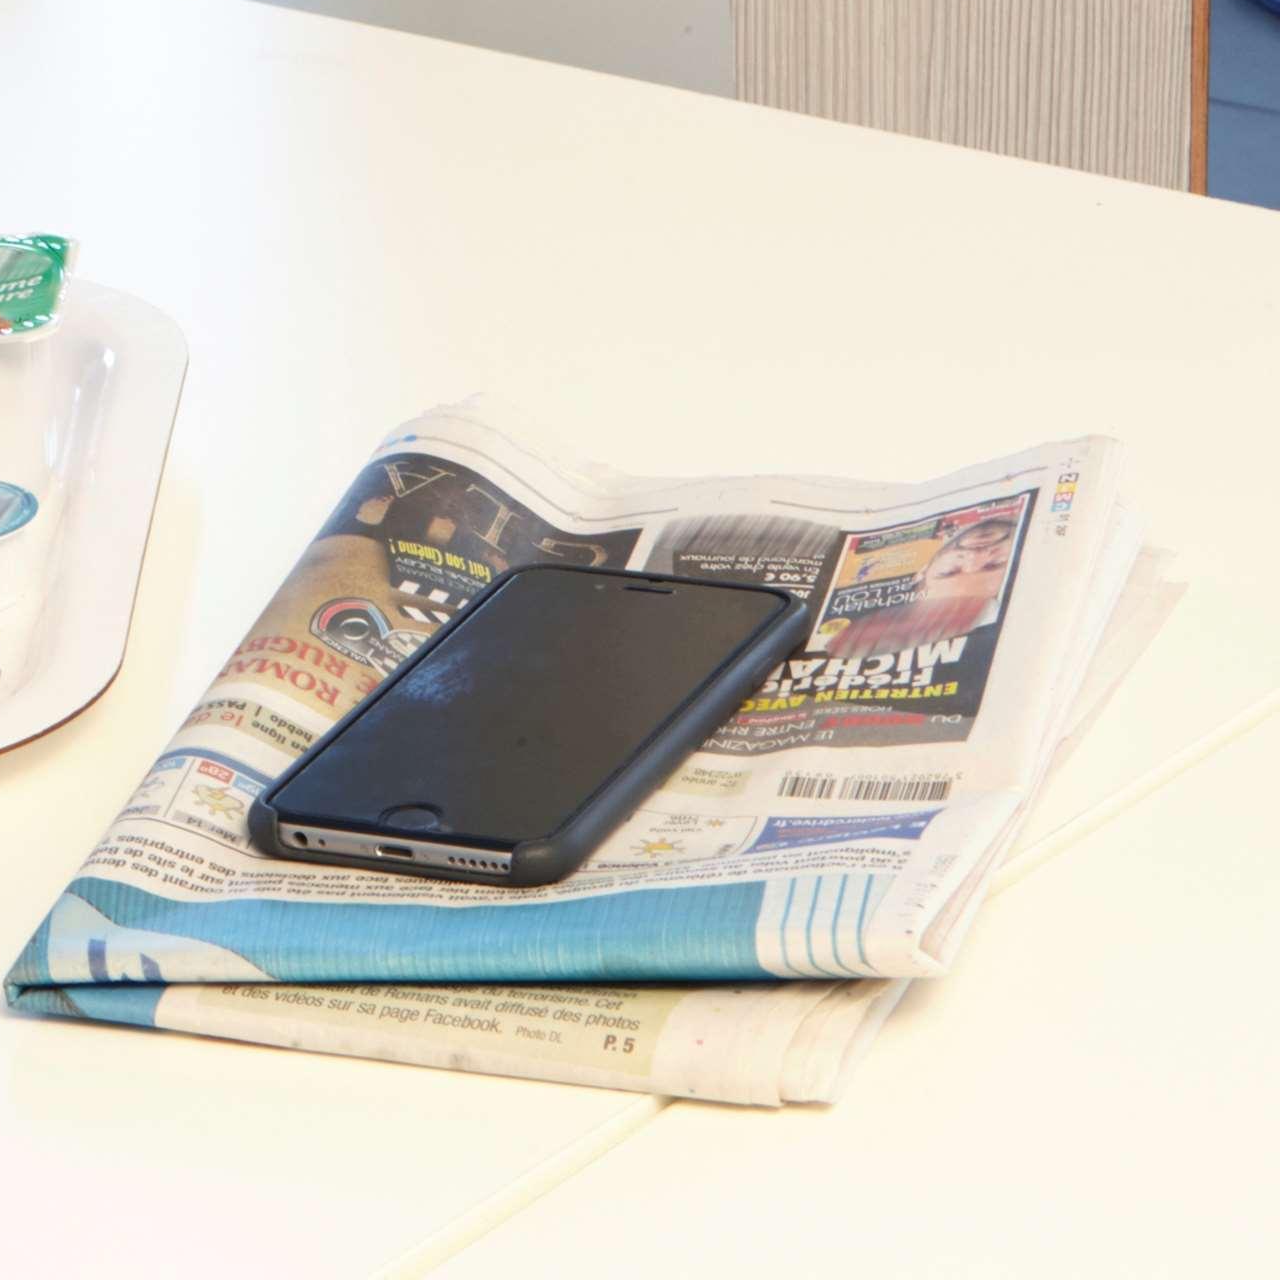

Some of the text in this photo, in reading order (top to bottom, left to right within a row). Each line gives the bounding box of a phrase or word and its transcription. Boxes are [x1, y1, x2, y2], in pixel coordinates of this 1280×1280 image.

[398, 541, 443, 566] Cinéma
[445, 553, 466, 571] son
[831, 590, 928, 615] Michalak
[739, 681, 959, 713] ENTRETIEN AVEC
[220, 711, 245, 728] le
[270, 714, 313, 743] hebdo
[751, 719, 816, 737] ENTRE
[251, 720, 287, 745] ligne
[815, 729, 835, 741] LE
[117, 835, 205, 865] entreprises
[123, 848, 144, 859] de
[131, 863, 159, 879] des
[147, 854, 177, 870] site
[209, 862, 237, 877] des
[180, 865, 195, 878] le
[198, 872, 225, 885] sur
[161, 874, 225, 894] courant
[241, 985, 271, 1001] des
[274, 990, 323, 1008] vidéos
[327, 998, 354, 1012] sur
[356, 1002, 377, 1016] sa
[378, 1005, 421, 1024] page
[423, 1008, 503, 1034] Facebook.
[515, 1025, 547, 1041] Photo
[595, 997, 624, 1011] Cet
[451, 997, 490, 1011] avait
[495, 1000, 549, 1018] diffusé
[552, 1007, 582, 1023] des
[584, 1013, 641, 1032] photos
[603, 1034, 636, 1054] P. 5
